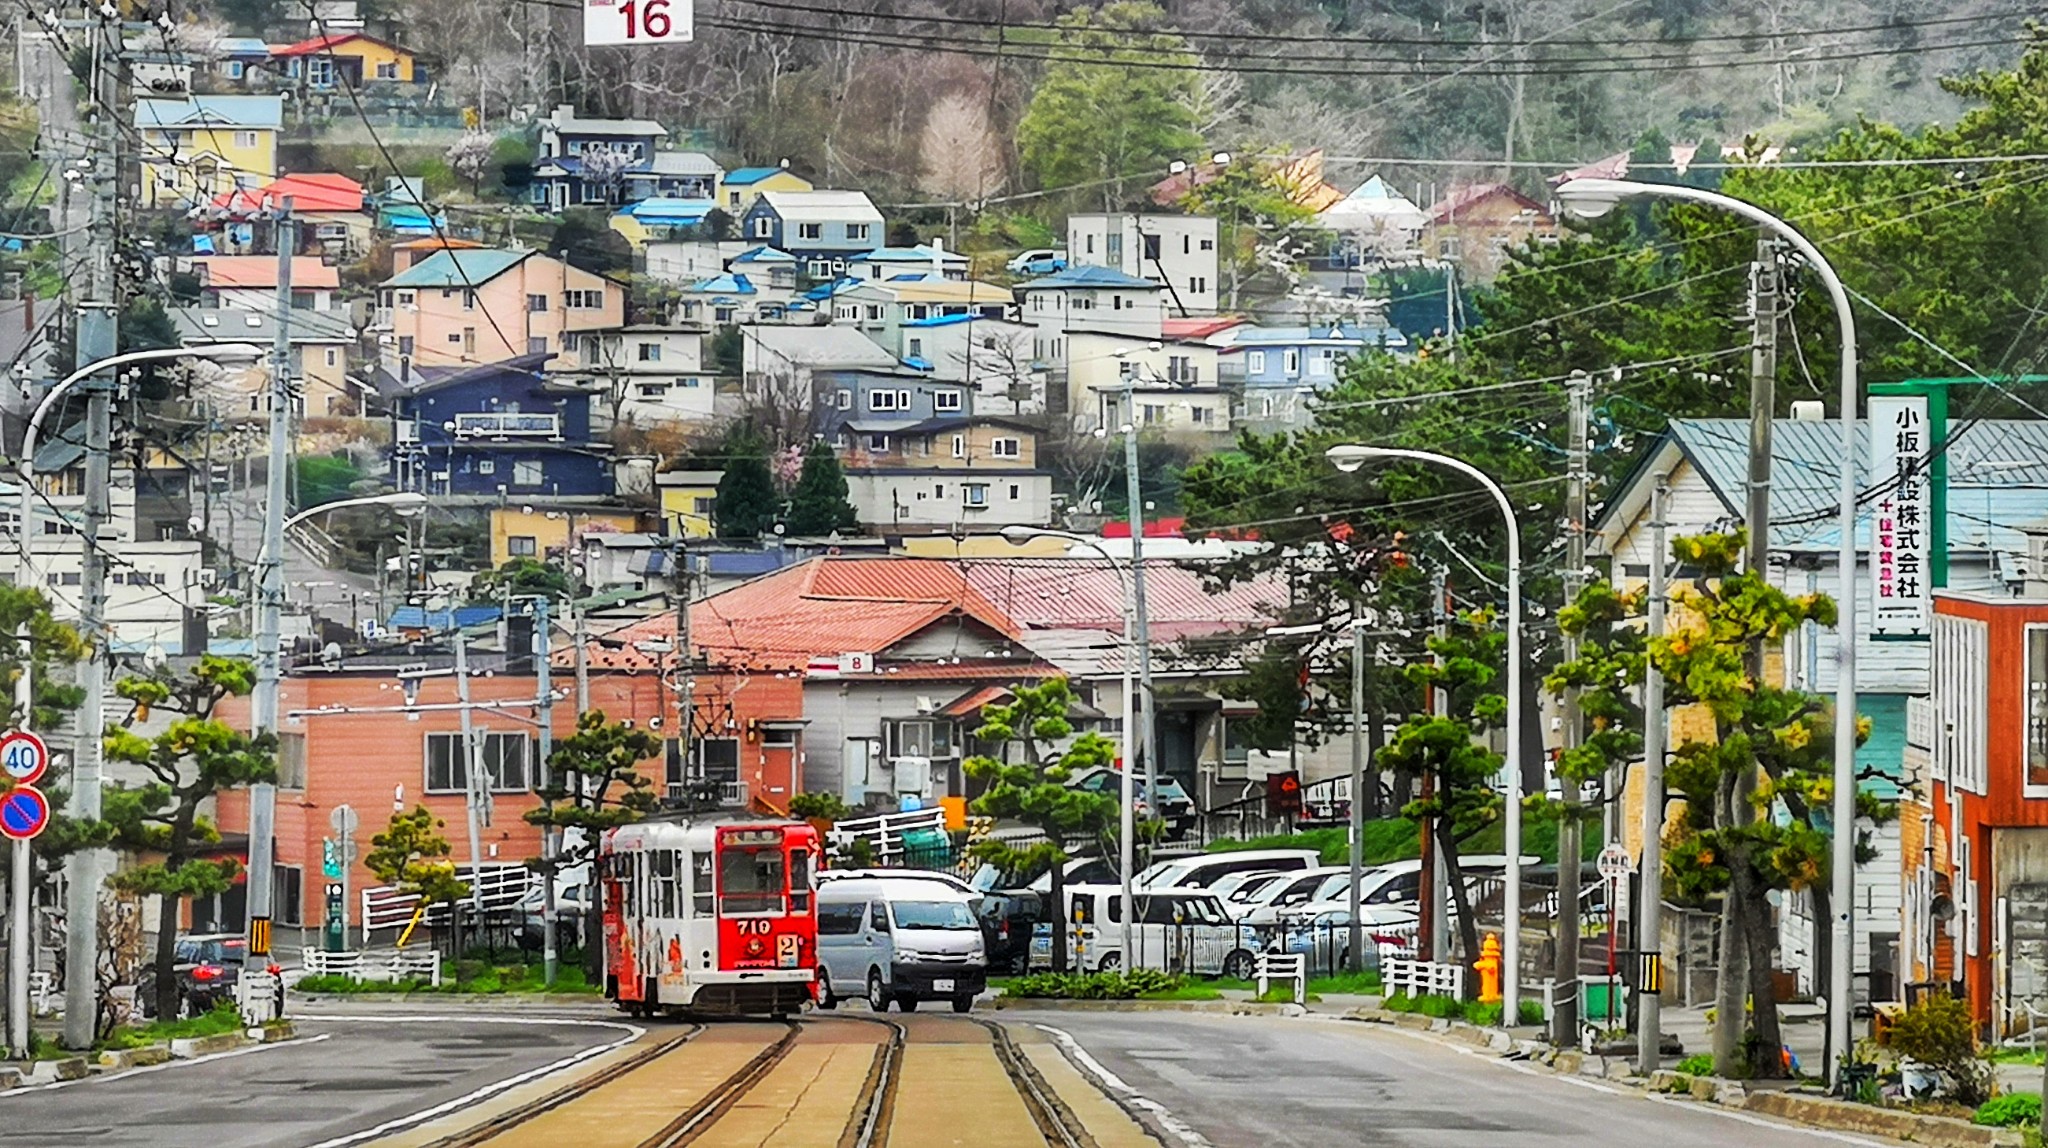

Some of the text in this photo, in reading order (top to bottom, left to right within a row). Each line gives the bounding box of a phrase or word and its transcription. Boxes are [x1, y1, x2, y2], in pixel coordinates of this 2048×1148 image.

[618, 0, 671, 39] 16
[852, 657, 861, 669] 8
[6, 746, 34, 768] 40
[781, 937, 793, 956] 2
